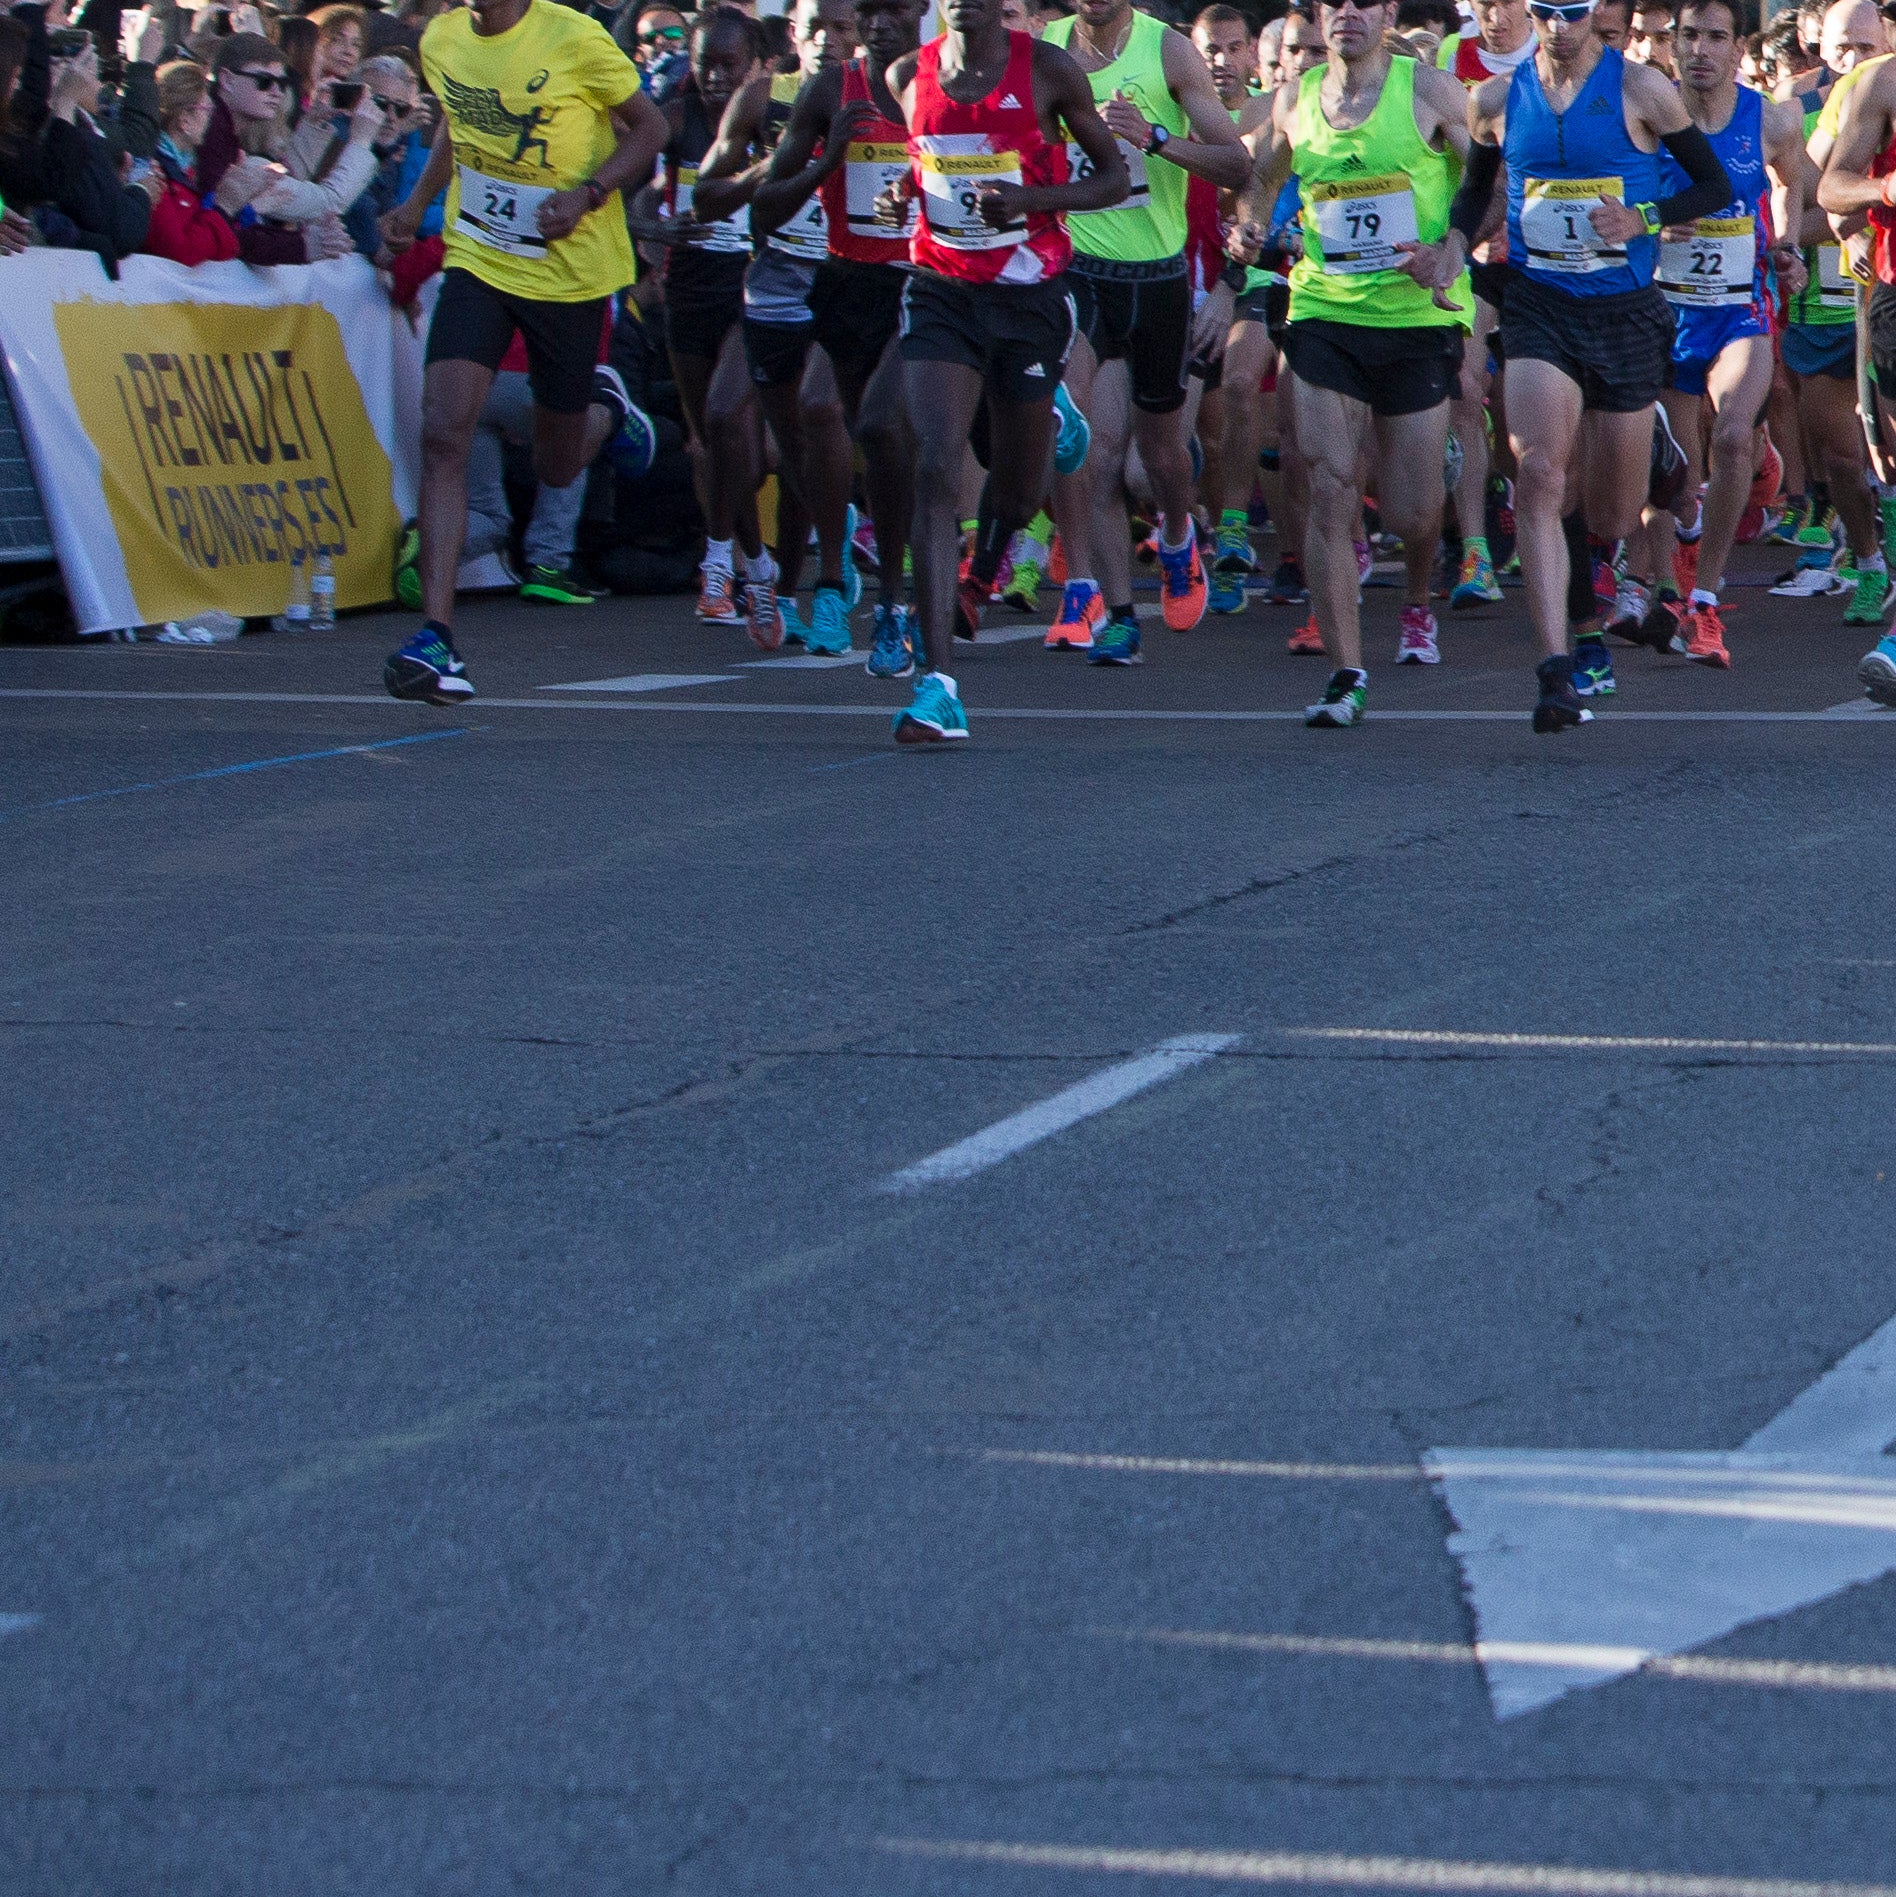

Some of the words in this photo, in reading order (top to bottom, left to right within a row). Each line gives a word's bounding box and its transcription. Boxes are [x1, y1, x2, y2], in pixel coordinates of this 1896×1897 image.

[484, 192, 517, 222] 24
[1344, 213, 1380, 239] 79
[1565, 216, 1578, 240] 1
[1690, 251, 1723, 276] 22
[123, 351, 312, 468] RENAULT
